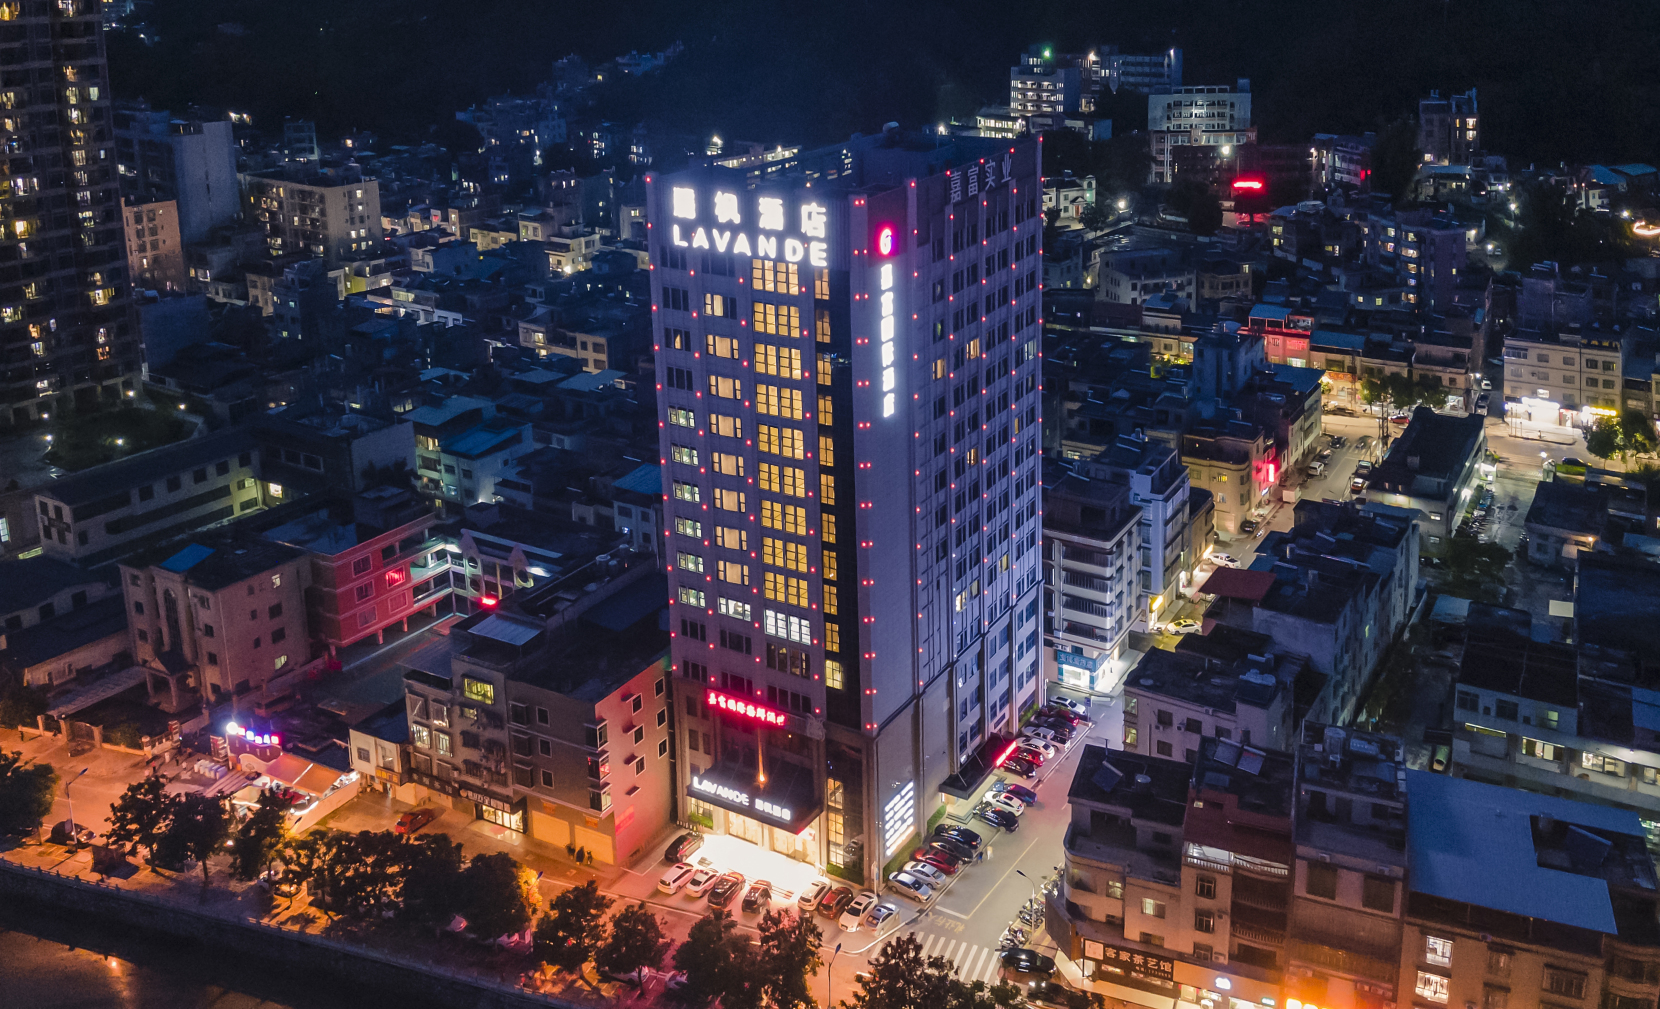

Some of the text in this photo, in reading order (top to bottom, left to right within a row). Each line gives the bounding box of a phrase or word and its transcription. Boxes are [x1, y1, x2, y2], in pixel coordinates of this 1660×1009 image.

[950, 153, 1012, 203] 嘉富实业
[672, 224, 828, 267] LAVANDE
[693, 776, 750, 806] LAVANDE
[1105, 947, 1172, 972] 客家茶艺馆
